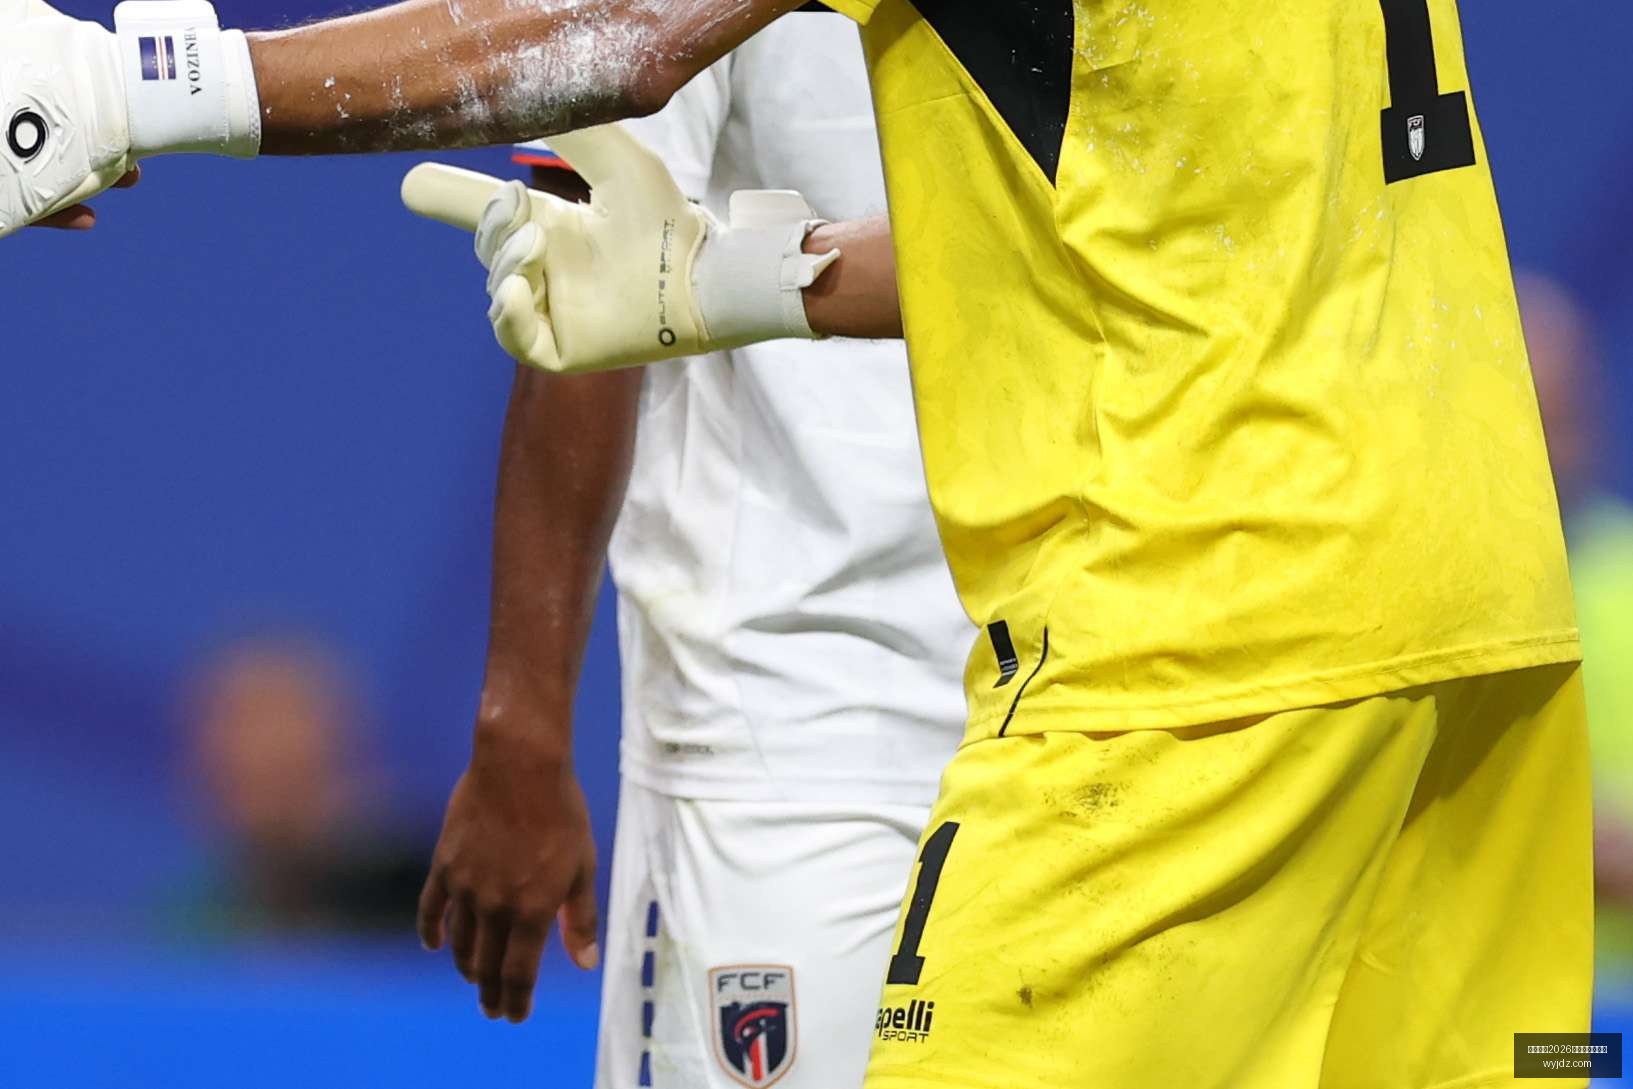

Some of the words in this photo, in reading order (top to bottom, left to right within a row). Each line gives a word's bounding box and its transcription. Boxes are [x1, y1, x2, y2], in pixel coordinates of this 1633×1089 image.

[886, 821, 960, 986] 1
[718, 972, 785, 992] FCF
[882, 1030, 929, 1043] SPORT
